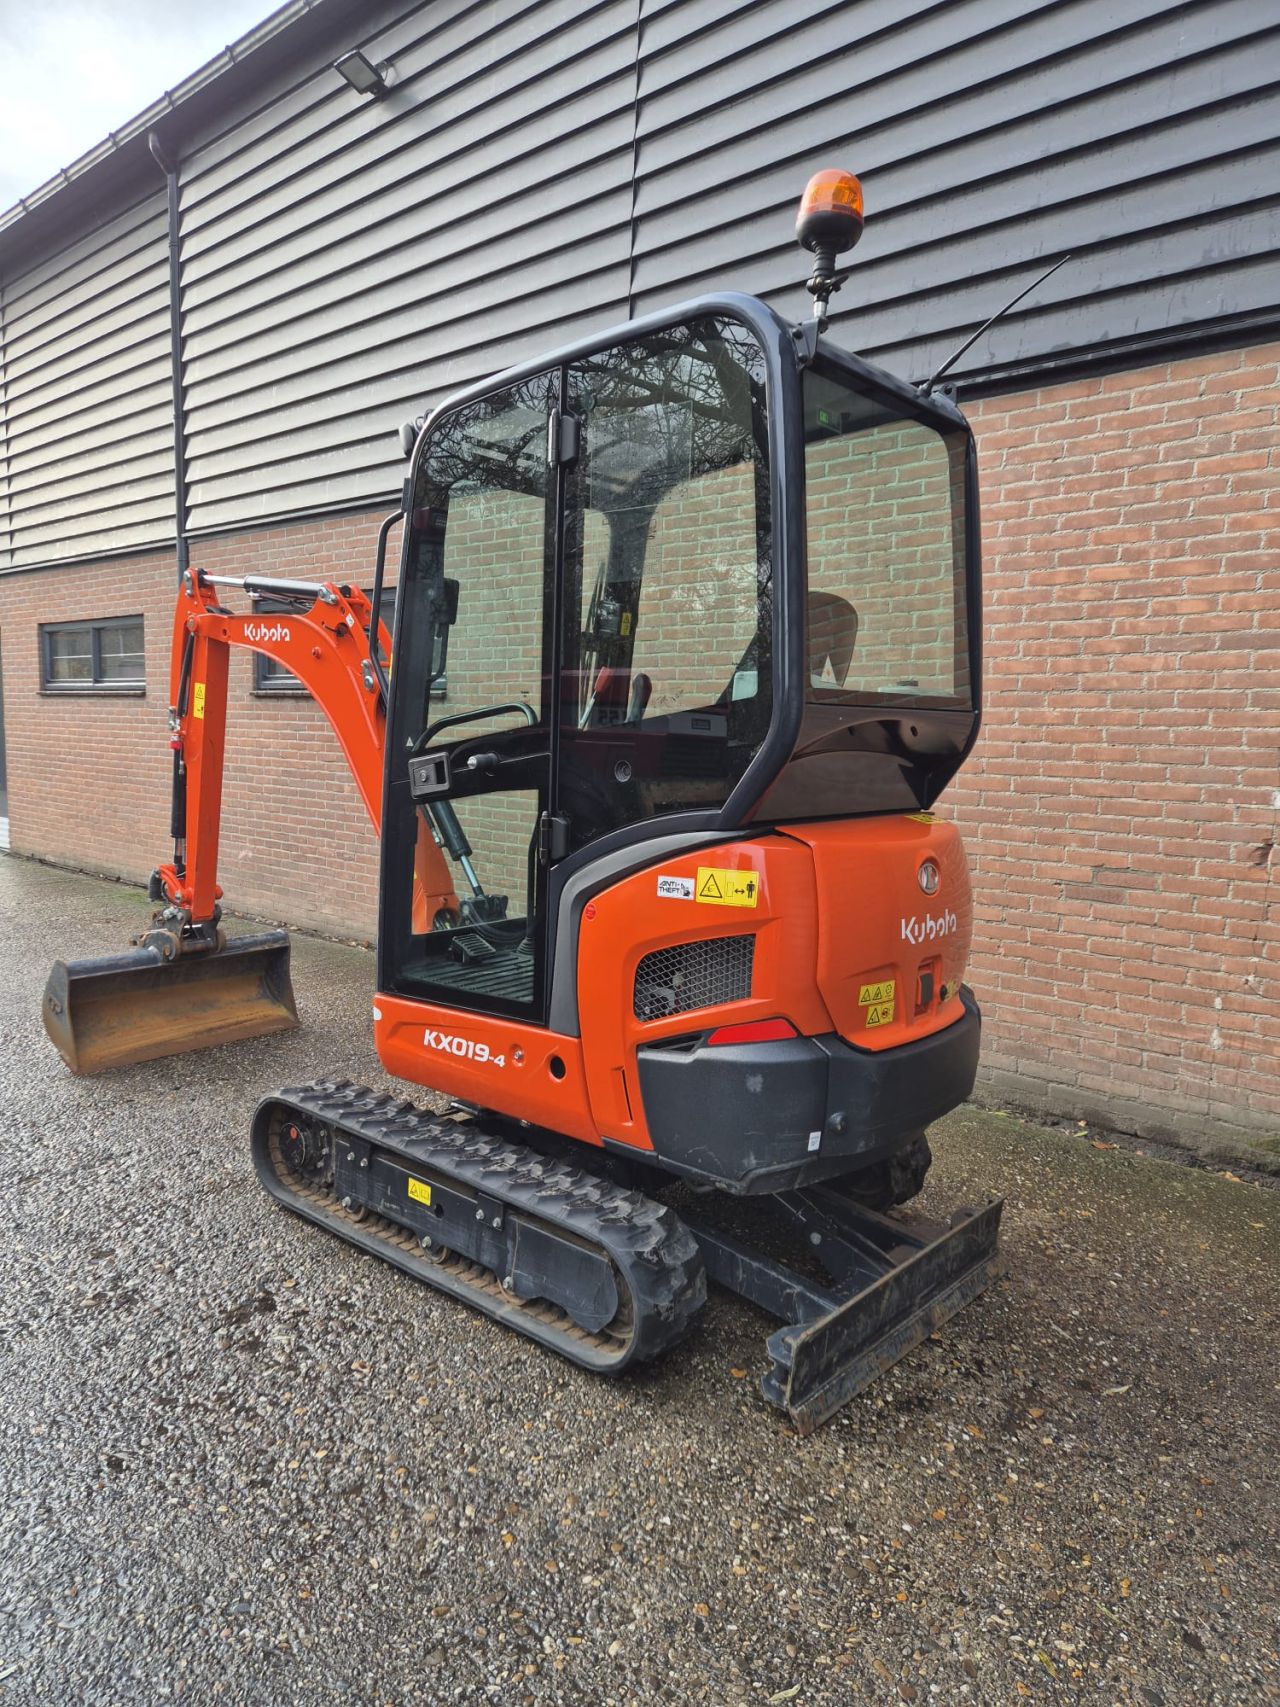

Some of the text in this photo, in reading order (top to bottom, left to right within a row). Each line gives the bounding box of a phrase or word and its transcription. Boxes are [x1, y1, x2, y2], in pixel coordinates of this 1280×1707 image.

[244, 623, 290, 642] Kubota
[659, 886, 680, 894] THEFT
[901, 908, 957, 945] Kubota
[423, 1028, 505, 1067] KX019-4
